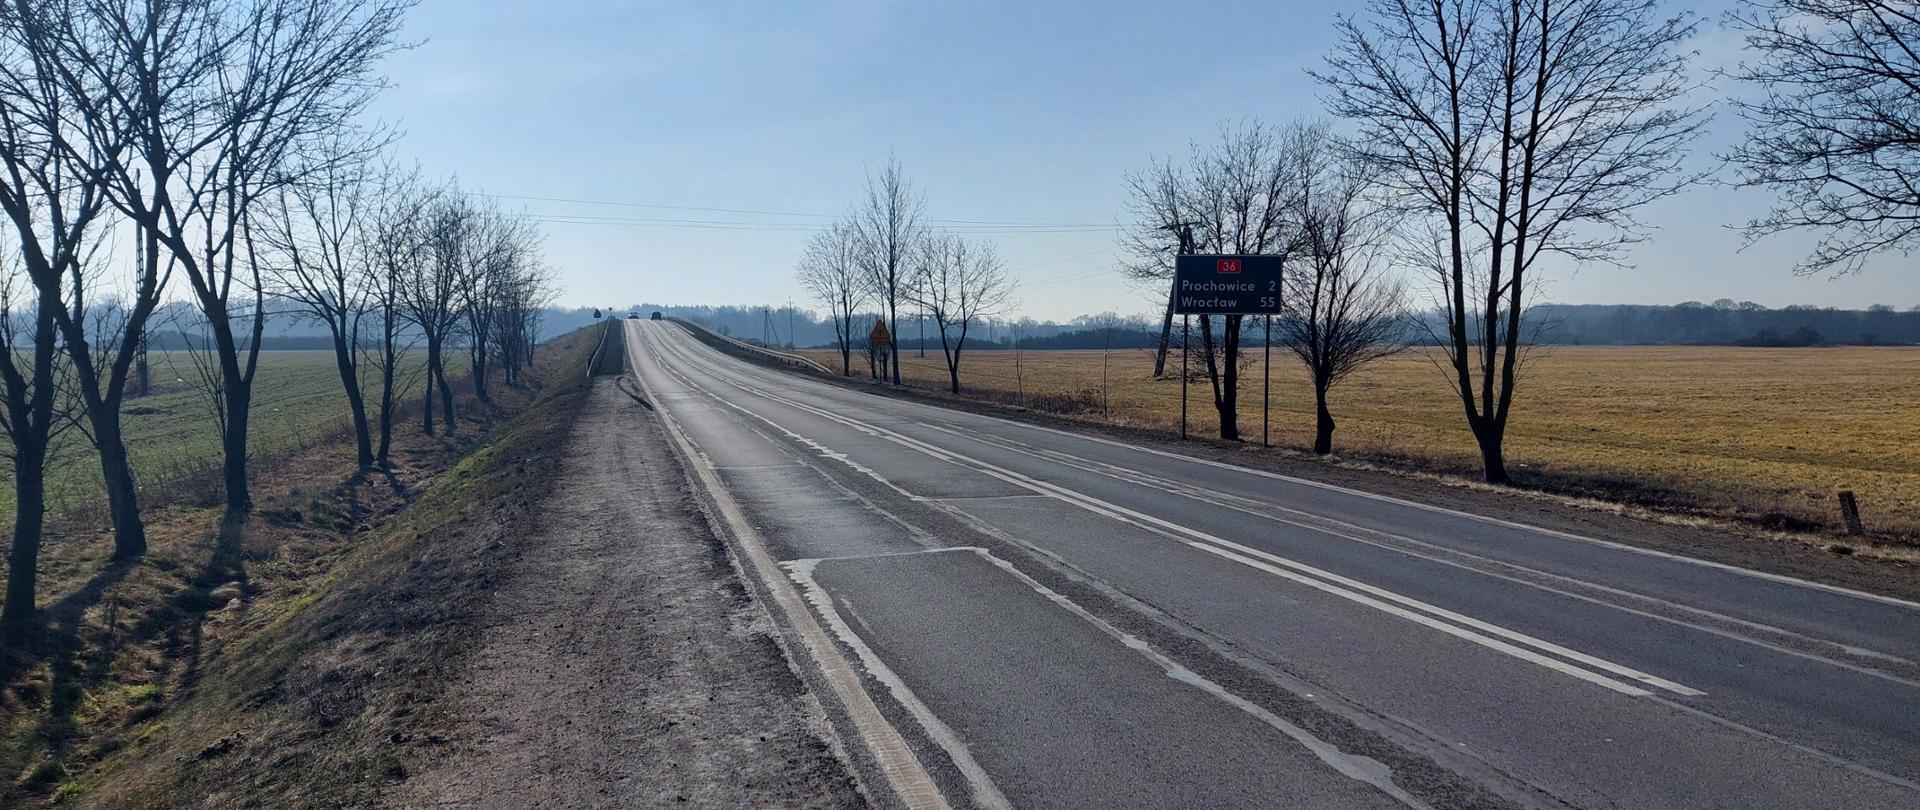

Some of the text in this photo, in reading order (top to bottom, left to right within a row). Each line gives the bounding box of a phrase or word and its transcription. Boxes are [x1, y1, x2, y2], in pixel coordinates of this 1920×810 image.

[1222, 262, 1236, 271] 36
[1182, 280, 1276, 291] Prochowice 2
[1182, 296, 1275, 307] Wrocław 55
